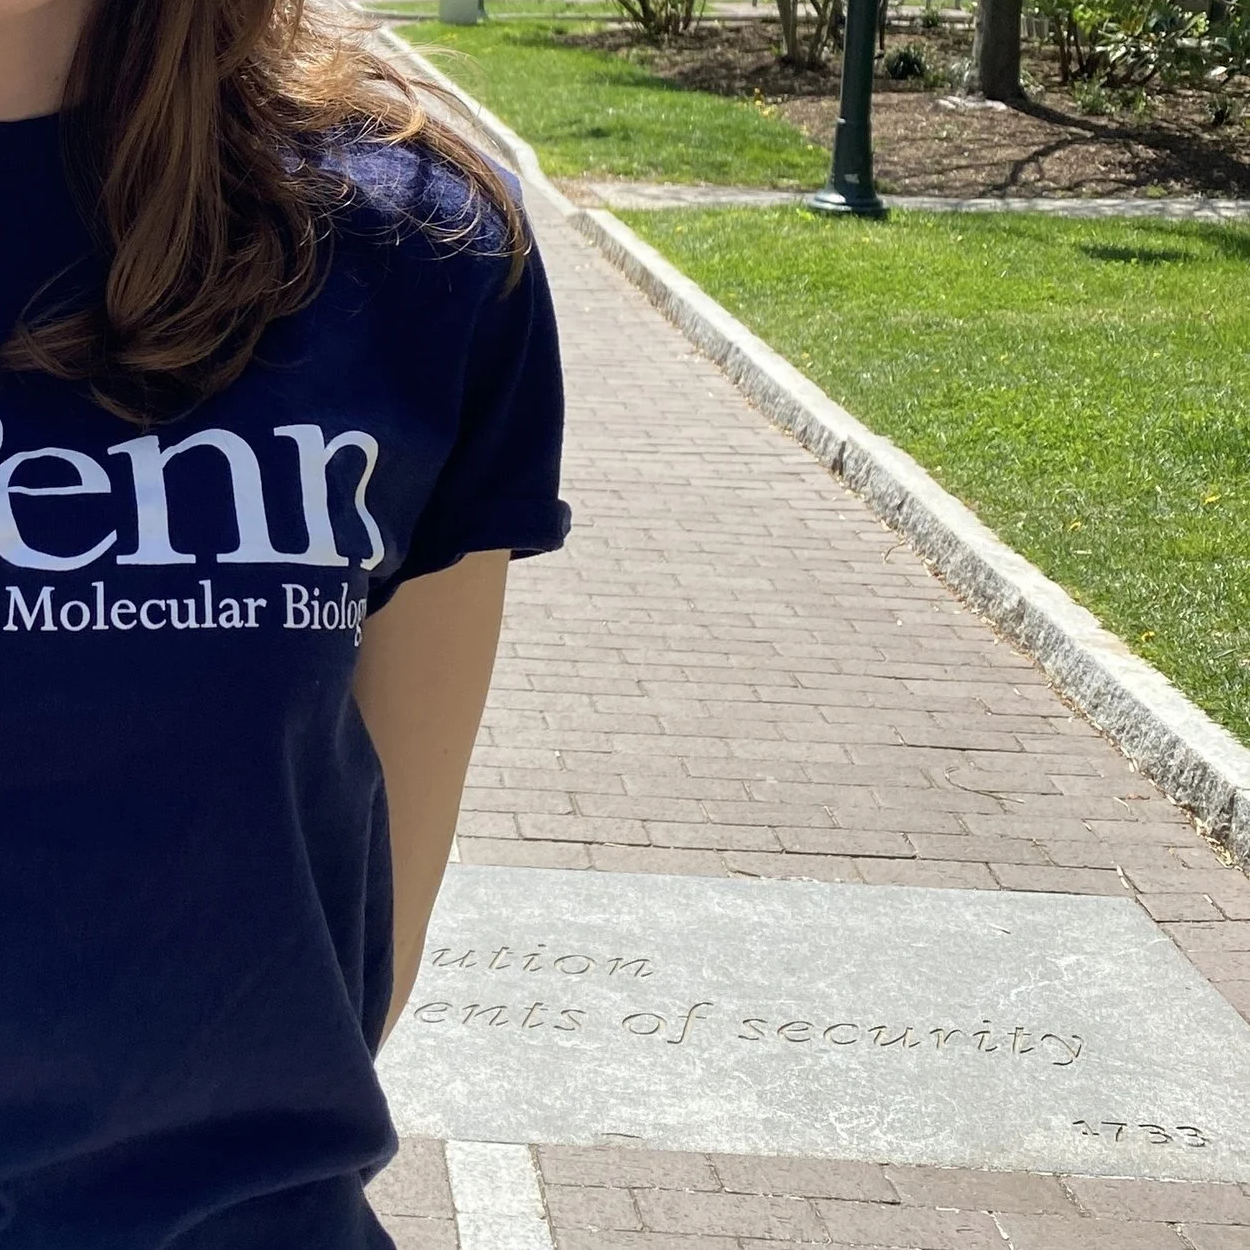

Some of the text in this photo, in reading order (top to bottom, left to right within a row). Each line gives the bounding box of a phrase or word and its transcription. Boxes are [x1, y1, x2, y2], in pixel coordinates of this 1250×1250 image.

[2, 579, 267, 632] Molecular
[281, 582, 367, 647] Biolog
[430, 943, 655, 978] ution
[414, 1001, 1084, 1066] ents of security
[1072, 1119, 1211, 1148] 1733
